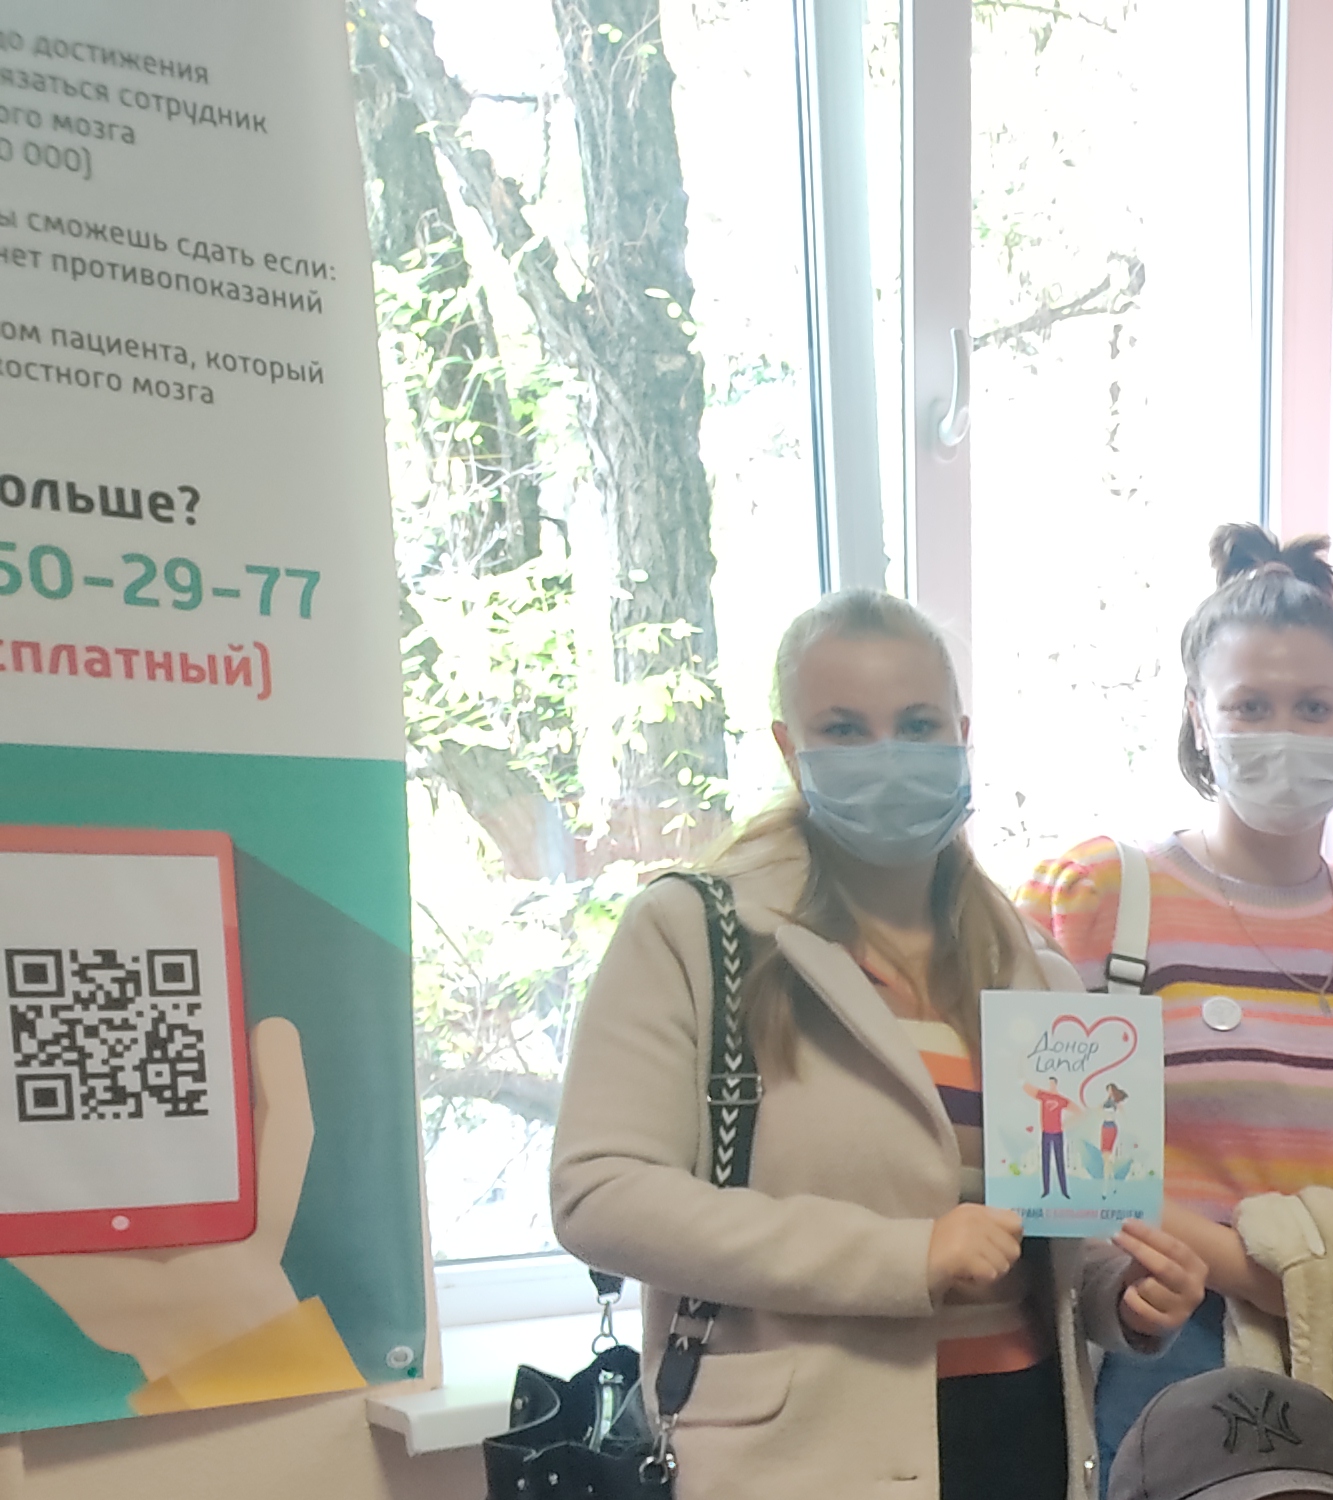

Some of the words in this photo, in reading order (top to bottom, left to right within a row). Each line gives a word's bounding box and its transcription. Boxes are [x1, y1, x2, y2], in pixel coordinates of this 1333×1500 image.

[33, 35, 210, 84] достижения
[53, 113, 136, 145] мозга
[119, 86, 268, 134] сотрудник
[24, 141, 92, 181] 000)
[27, 211, 168, 253] сможешь
[177, 236, 255, 269] сдать
[264, 252, 337, 281] если:
[51, 253, 324, 315] противопоказаний
[51, 327, 197, 369] пациента,
[206, 349, 325, 385] который
[133, 377, 216, 404] мозга
[0, 474, 200, 526] ольше?
[0, 540, 321, 619] 50-29-77
[1027, 1031, 1100, 1060] Донор
